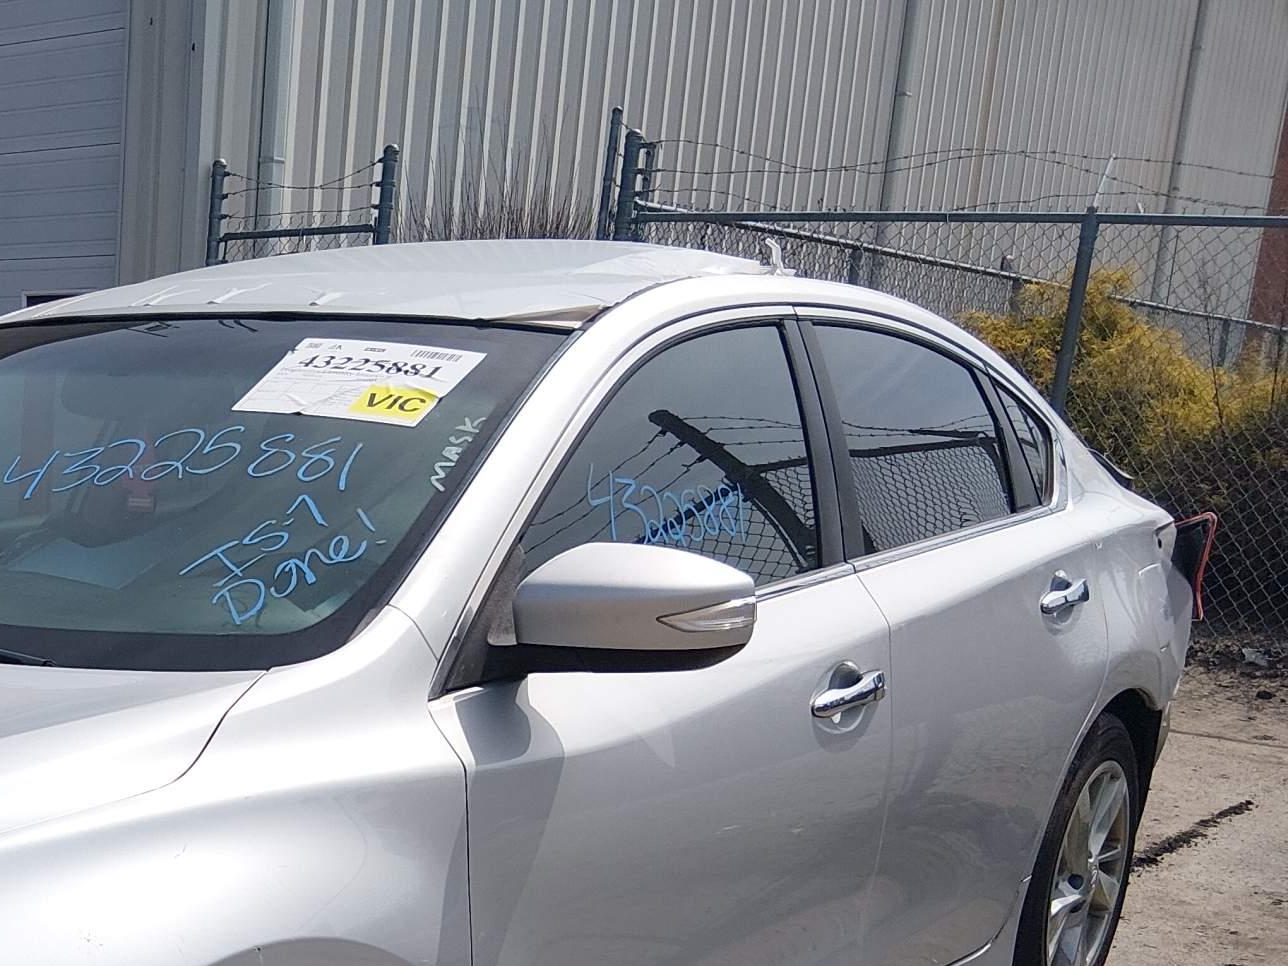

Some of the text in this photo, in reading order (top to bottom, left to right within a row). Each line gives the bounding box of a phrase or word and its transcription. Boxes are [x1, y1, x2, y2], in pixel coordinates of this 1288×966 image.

[298, 353, 443, 379] 43225881
[367, 392, 427, 412] VIC
[3, 426, 363, 500] 43225881
[430, 416, 487, 492] MASK
